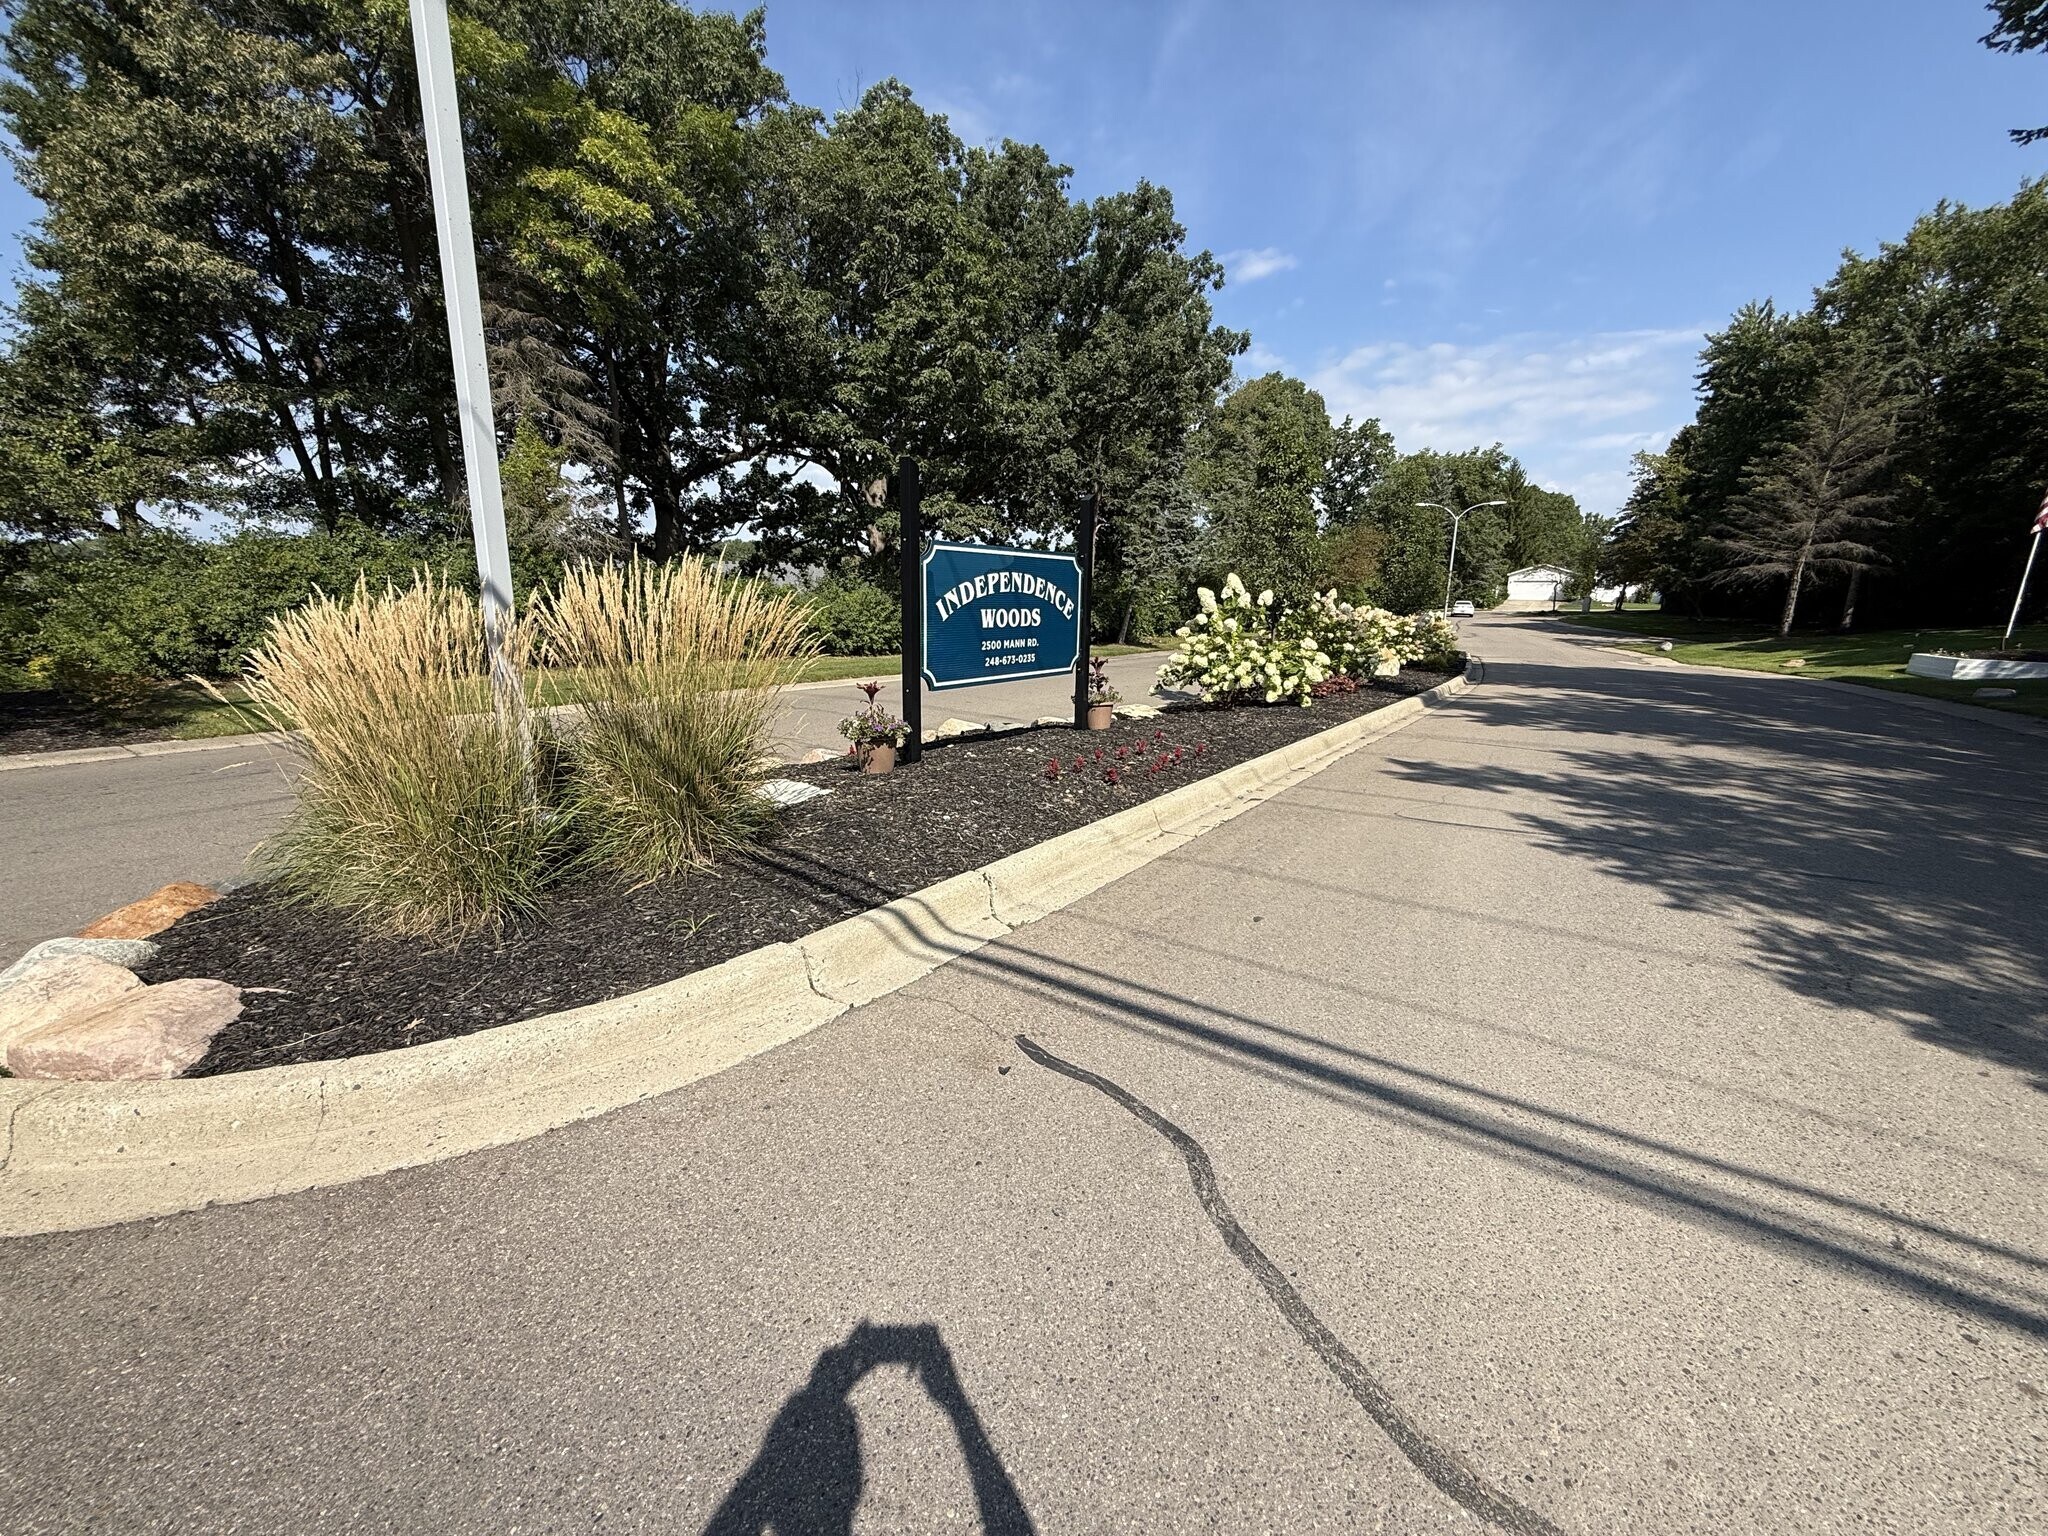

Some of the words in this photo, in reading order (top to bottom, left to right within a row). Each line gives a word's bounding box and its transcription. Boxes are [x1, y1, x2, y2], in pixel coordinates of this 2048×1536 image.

[935, 572, 1075, 622] INDEPENDENCE
[980, 608, 1041, 628] WOODS
[981, 640, 1002, 650] 2500
[1003, 639, 1026, 649] MANN
[1027, 638, 1039, 647] RD.
[985, 654, 1036, 667] 248-673-0235
